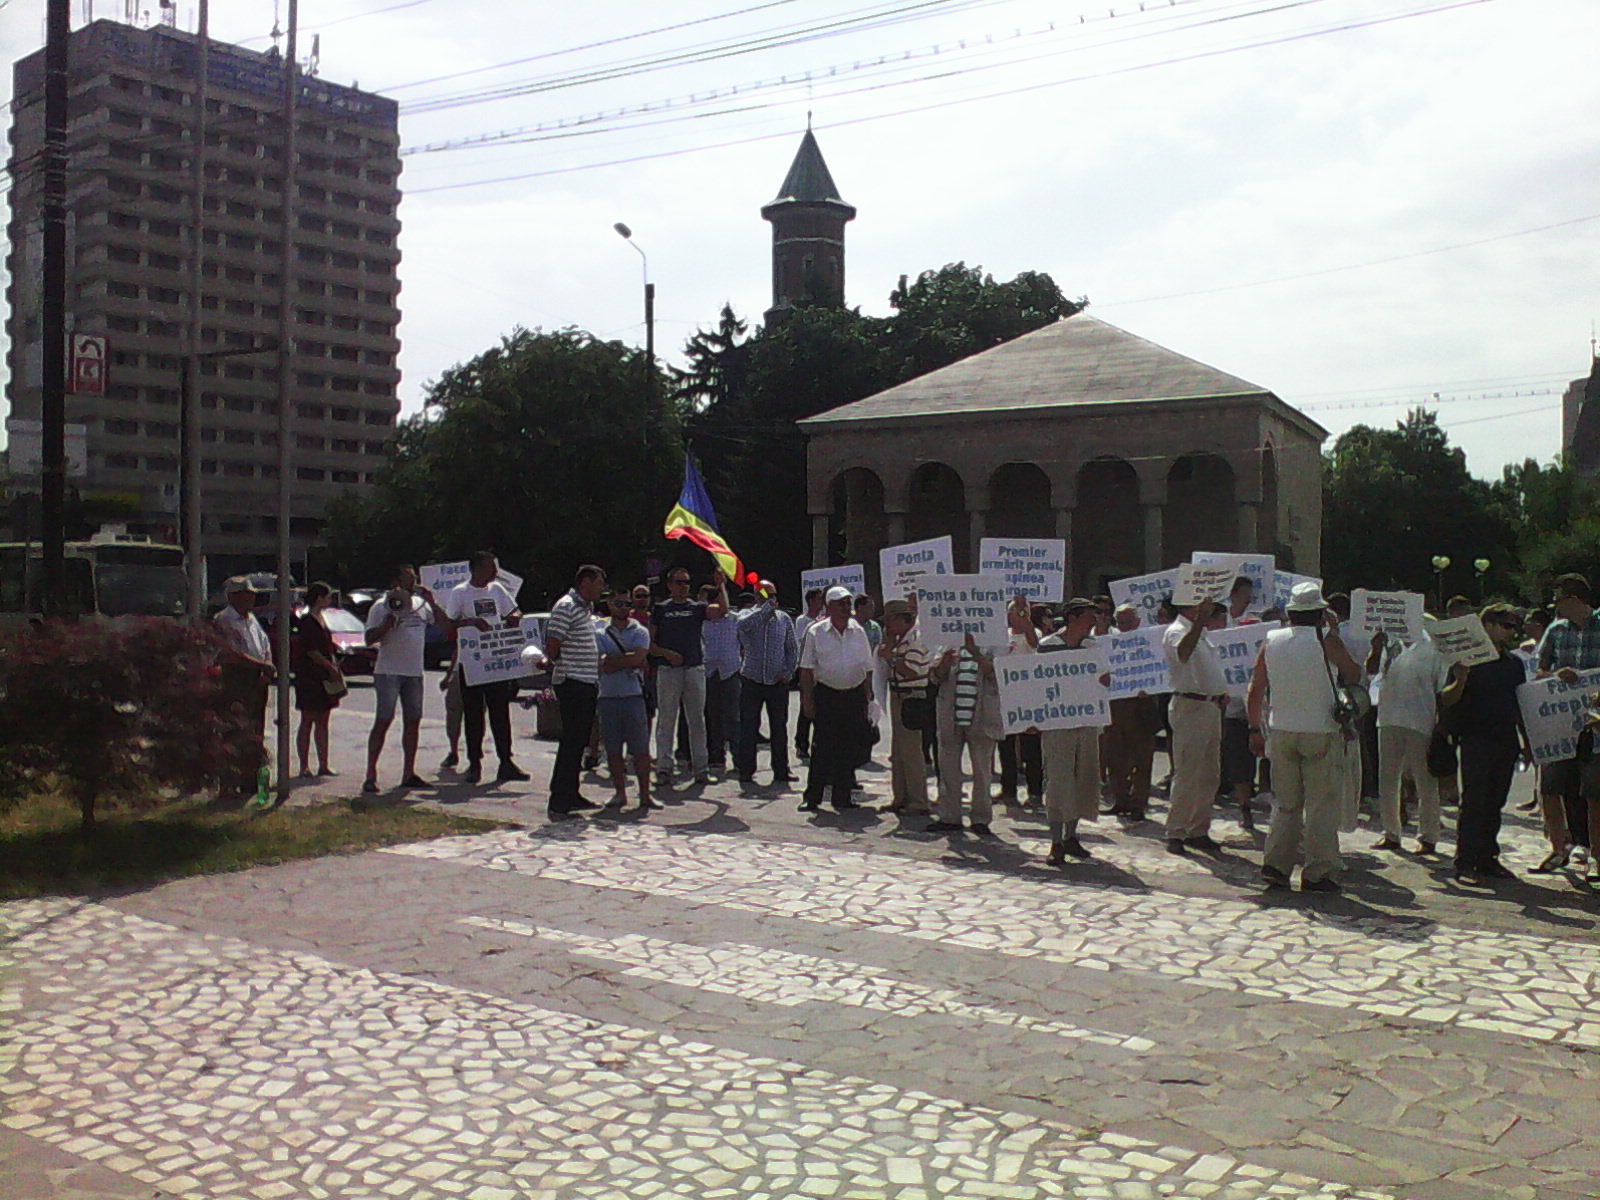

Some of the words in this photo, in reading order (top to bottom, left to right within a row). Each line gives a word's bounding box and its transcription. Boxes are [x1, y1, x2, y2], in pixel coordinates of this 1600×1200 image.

[896, 549, 934, 566] Ponta
[998, 545, 1047, 558] Premier
[1128, 578, 1171, 594] Ponta
[918, 588, 956, 602] Ponta
[960, 591, 967, 602] a
[971, 587, 1004, 602] furat
[946, 606, 961, 617] se
[964, 606, 994, 617] vrea
[1003, 668, 1029, 686] Jos
[1033, 662, 1097, 679] dottore
[1045, 682, 1060, 702] și
[1007, 703, 1095, 726] plagiatore
